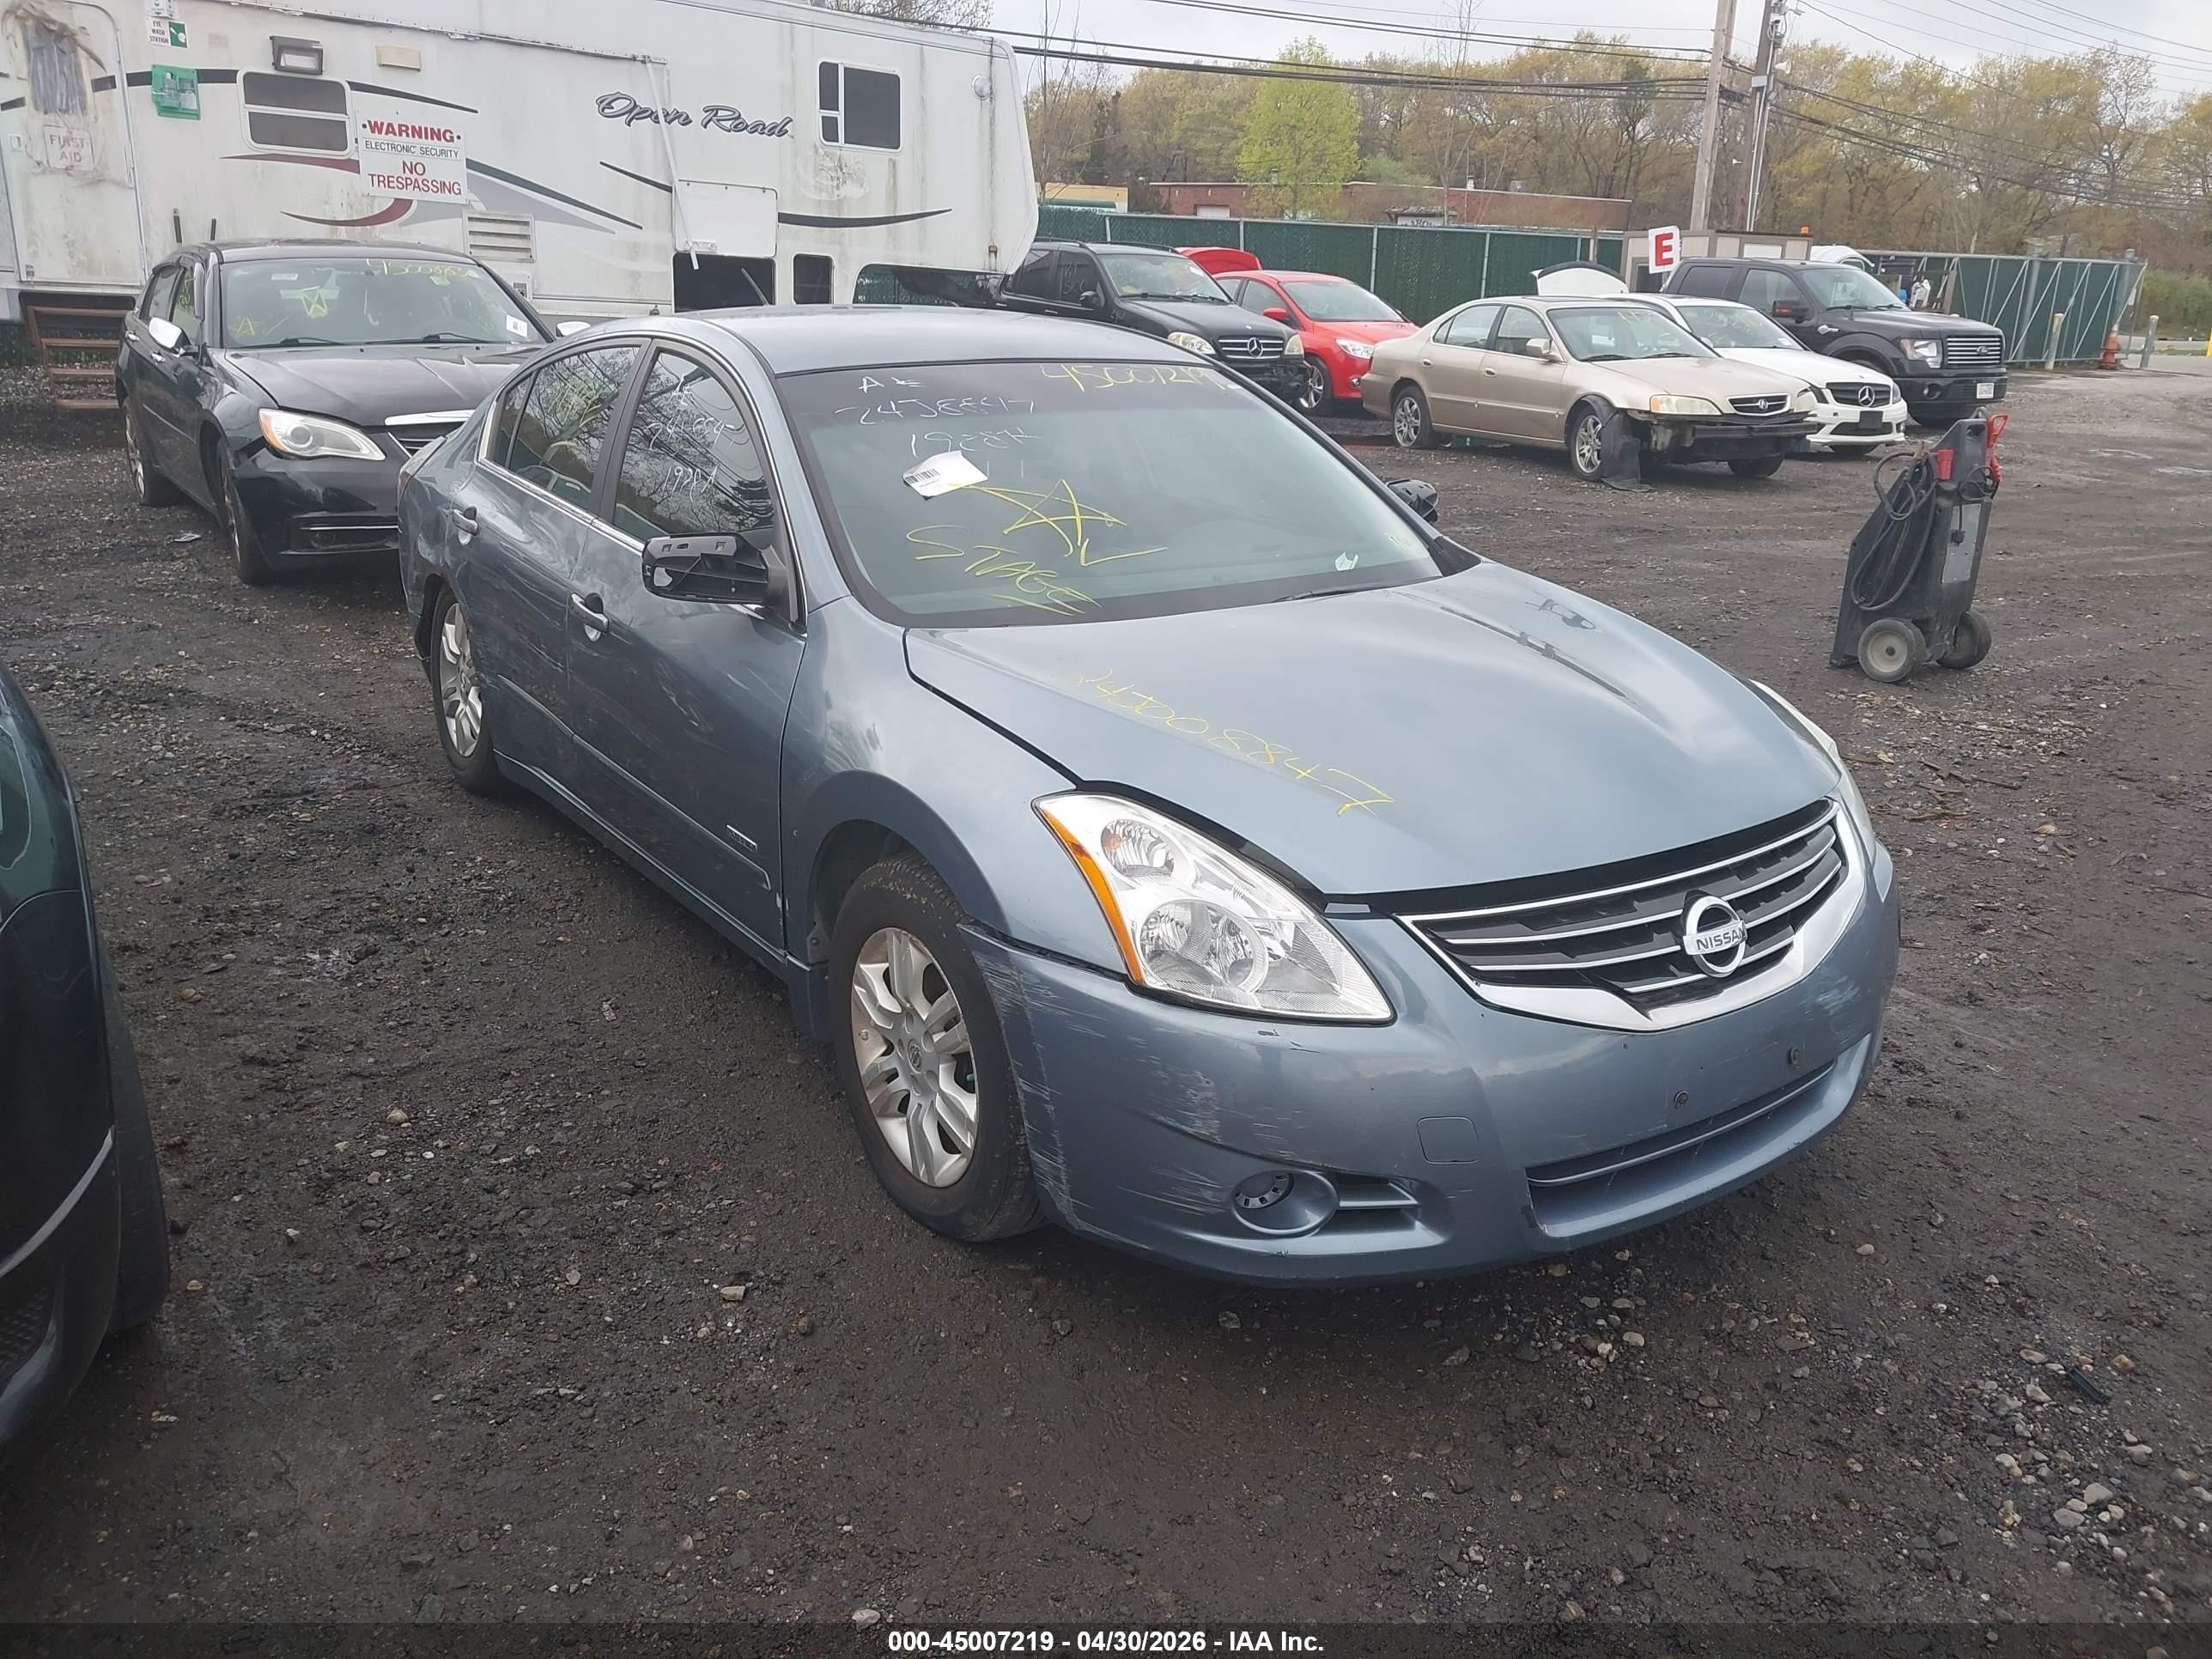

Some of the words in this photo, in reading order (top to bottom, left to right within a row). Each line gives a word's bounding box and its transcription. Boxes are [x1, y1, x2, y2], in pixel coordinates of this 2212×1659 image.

[595, 91, 694, 127] Open
[701, 105, 793, 137] Road
[49, 134, 85, 149] FIRST
[367, 119, 455, 143] WARNING
[60, 150, 82, 163] AID
[365, 140, 416, 155] ELECTRONIC
[419, 146, 459, 159] SECURITY
[402, 160, 426, 176] NO
[368, 173, 462, 196] TRESPASSING
[1655, 232, 1674, 267] E
[1696, 927, 1747, 951] NISSAN
